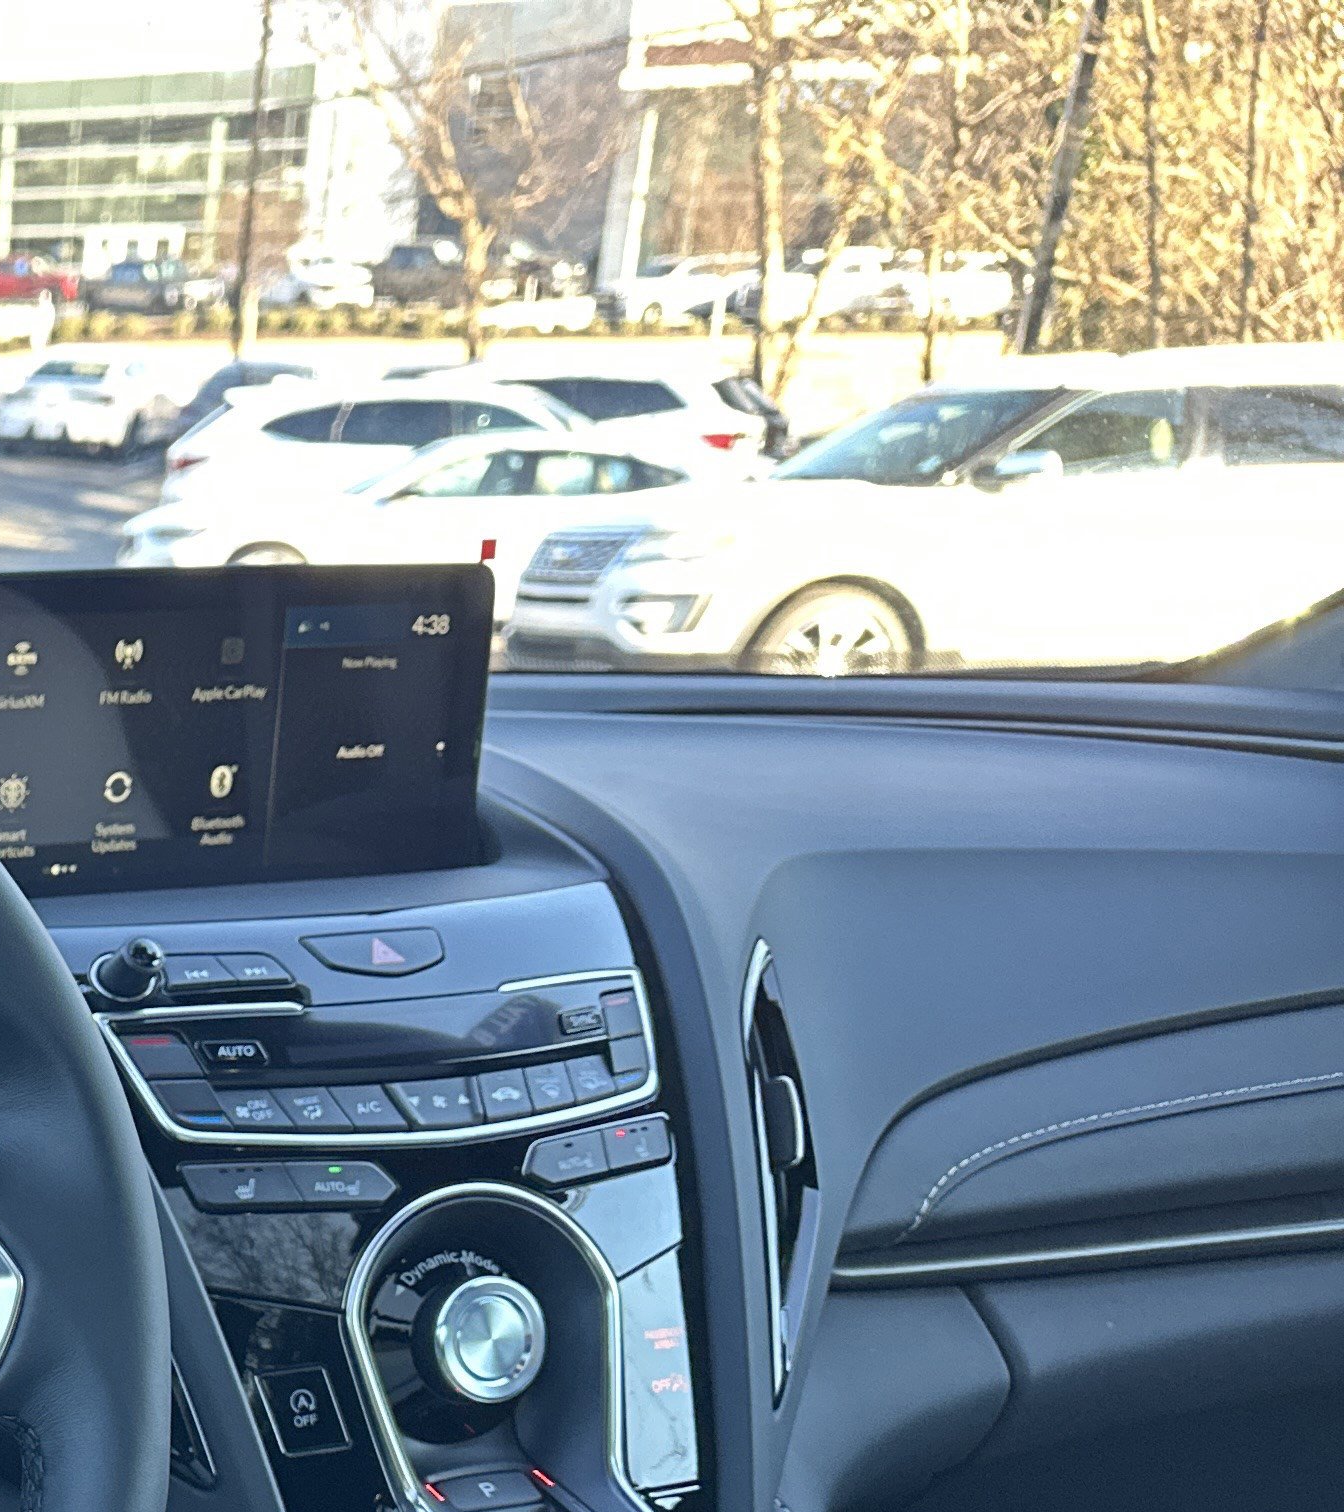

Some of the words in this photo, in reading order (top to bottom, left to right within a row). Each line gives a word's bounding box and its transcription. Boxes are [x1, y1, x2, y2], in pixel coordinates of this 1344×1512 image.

[412, 613, 451, 636] 4:38
[364, 655, 398, 671] Playing
[99, 691, 119, 706] FM
[121, 689, 153, 704] Radio
[191, 686, 223, 704] Apple
[95, 821, 136, 838] System
[190, 814, 246, 832] Bluetooth
[91, 839, 138, 855] Updates
[199, 832, 234, 846] Audio
[217, 1045, 256, 1057] AUTO
[314, 1181, 345, 1193] AUTO
[399, 1249, 460, 1287] Dynamic
[460, 1249, 501, 1275] Mode
[293, 1413, 317, 1428] OFF
[478, 1481, 496, 1499] P
